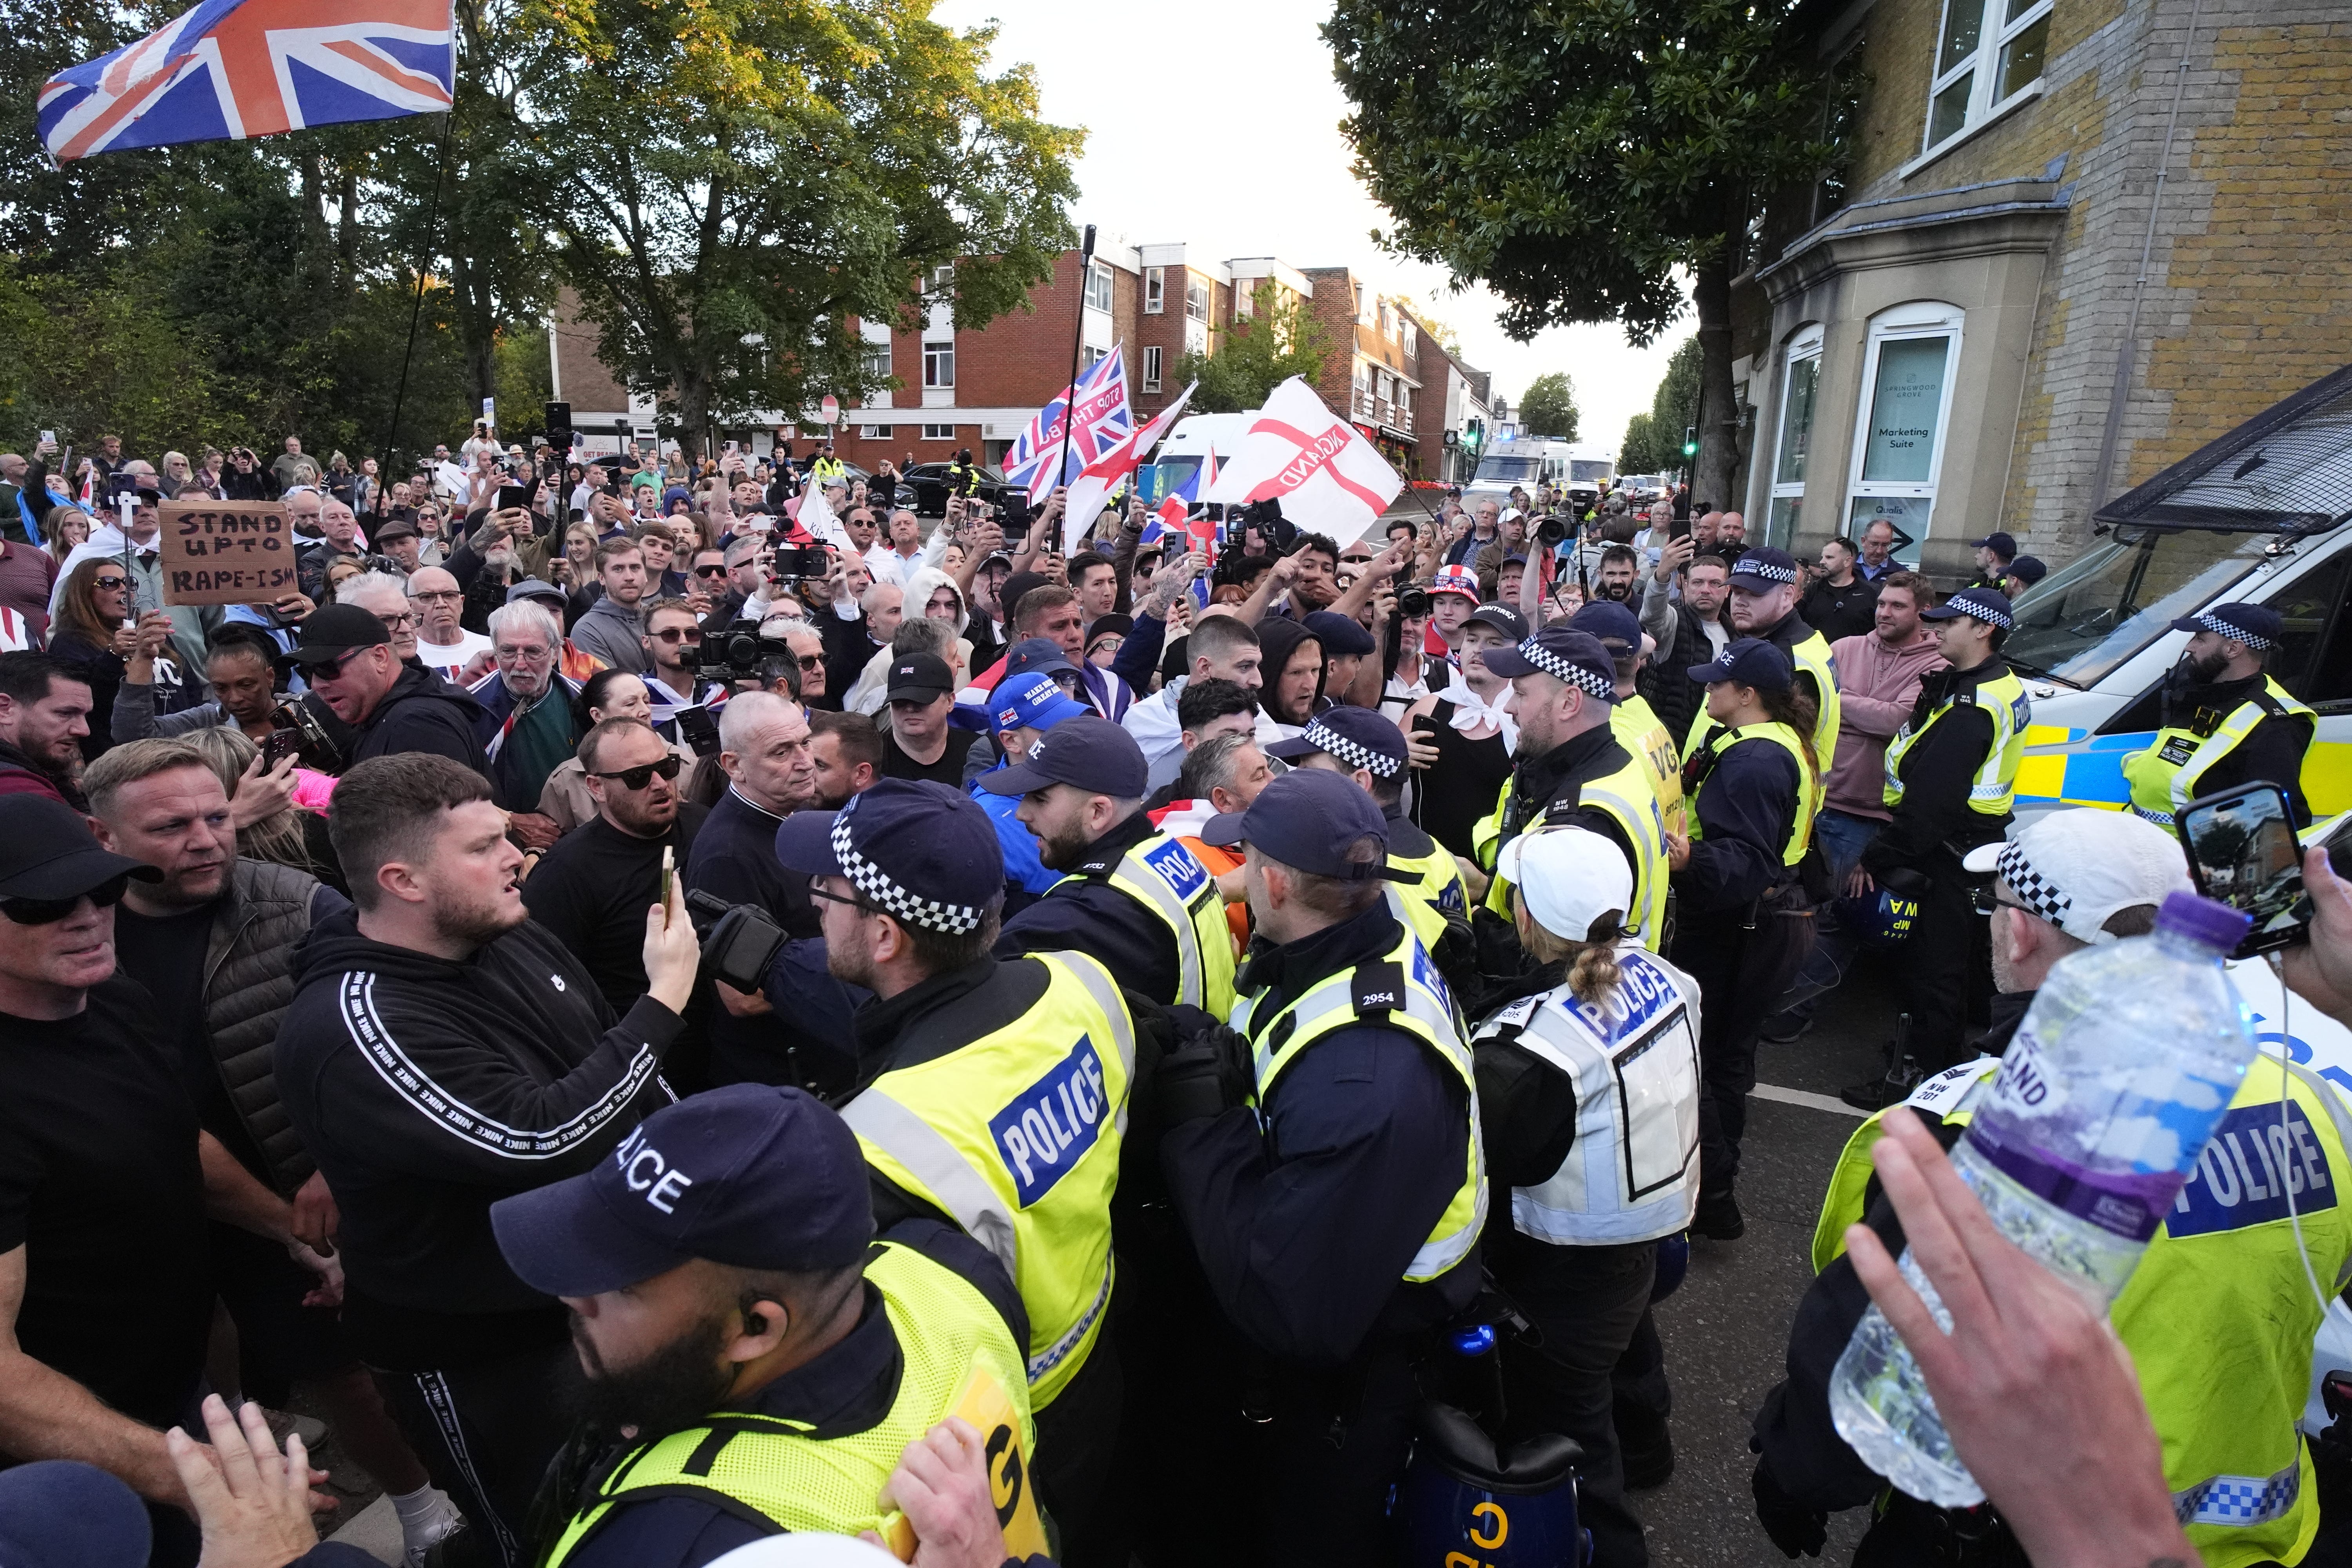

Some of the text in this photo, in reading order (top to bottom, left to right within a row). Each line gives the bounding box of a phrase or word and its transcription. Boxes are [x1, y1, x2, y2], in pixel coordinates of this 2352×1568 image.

[1879, 428, 1928, 437] Marketing
[1876, 506, 1903, 515] Qualis
[178, 513, 281, 535] STAND
[172, 568, 296, 593] RAPE-ISM
[1024, 684, 1044, 701] MAKE
[1032, 689, 1053, 706] GREAT
[1650, 741, 1677, 781] VG
[1890, 899, 1917, 917] WA
[1893, 920, 1911, 930] MP
[1363, 992, 1394, 1005] 2954
[358, 1016, 377, 1044] NIKE
[373, 1042, 397, 1068] NIKE
[394, 1067, 421, 1092] NIKE
[419, 1089, 447, 1114] NIKE
[446, 1110, 474, 1130] NIKE
[475, 1125, 504, 1143] NIKE
[505, 1138, 530, 1150] NIKE
[563, 1122, 588, 1142] NIKE
[588, 1102, 614, 1124] NIKE
[613, 1079, 635, 1103] NIKE
[633, 1053, 653, 1078] NIKE
[1927, 1083, 1950, 1093] NW
[1917, 1091, 1938, 1101] 201
[1002, 1052, 1103, 1188] POLICE
[2174, 1120, 2327, 1214] POLICE
